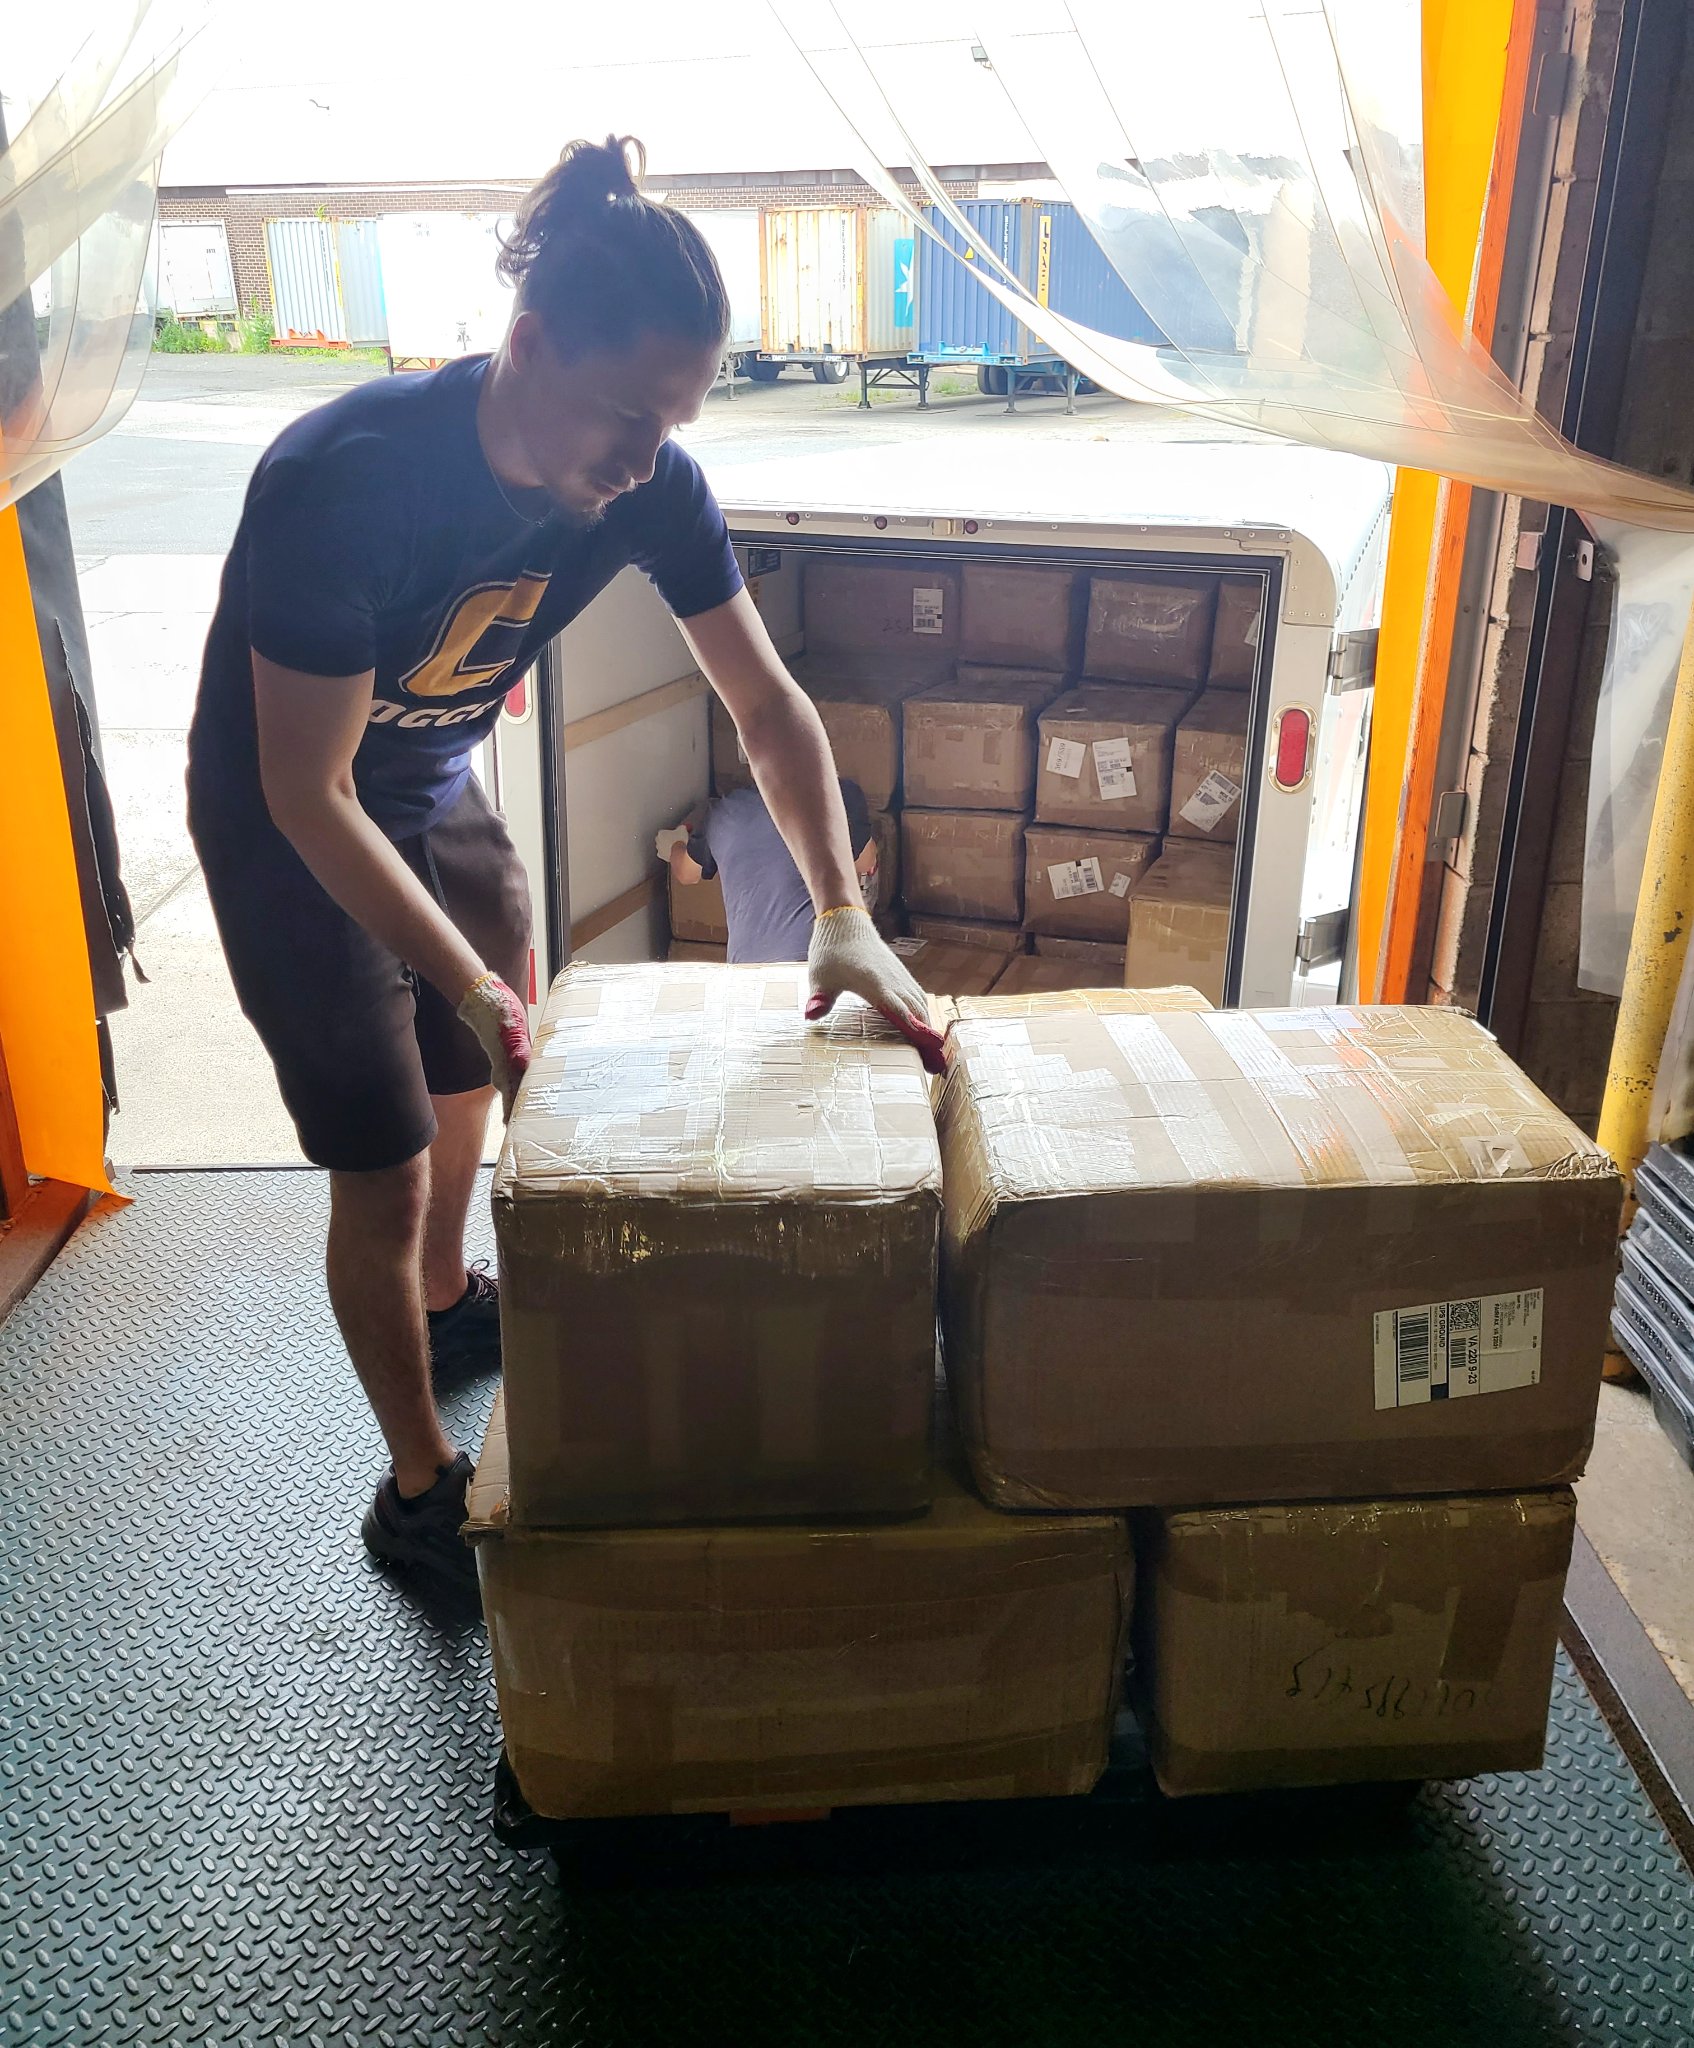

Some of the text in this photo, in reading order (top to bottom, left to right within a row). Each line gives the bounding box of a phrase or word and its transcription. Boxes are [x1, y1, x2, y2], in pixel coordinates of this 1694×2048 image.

[1468, 1335, 1478, 1385] VA 220 9-23
